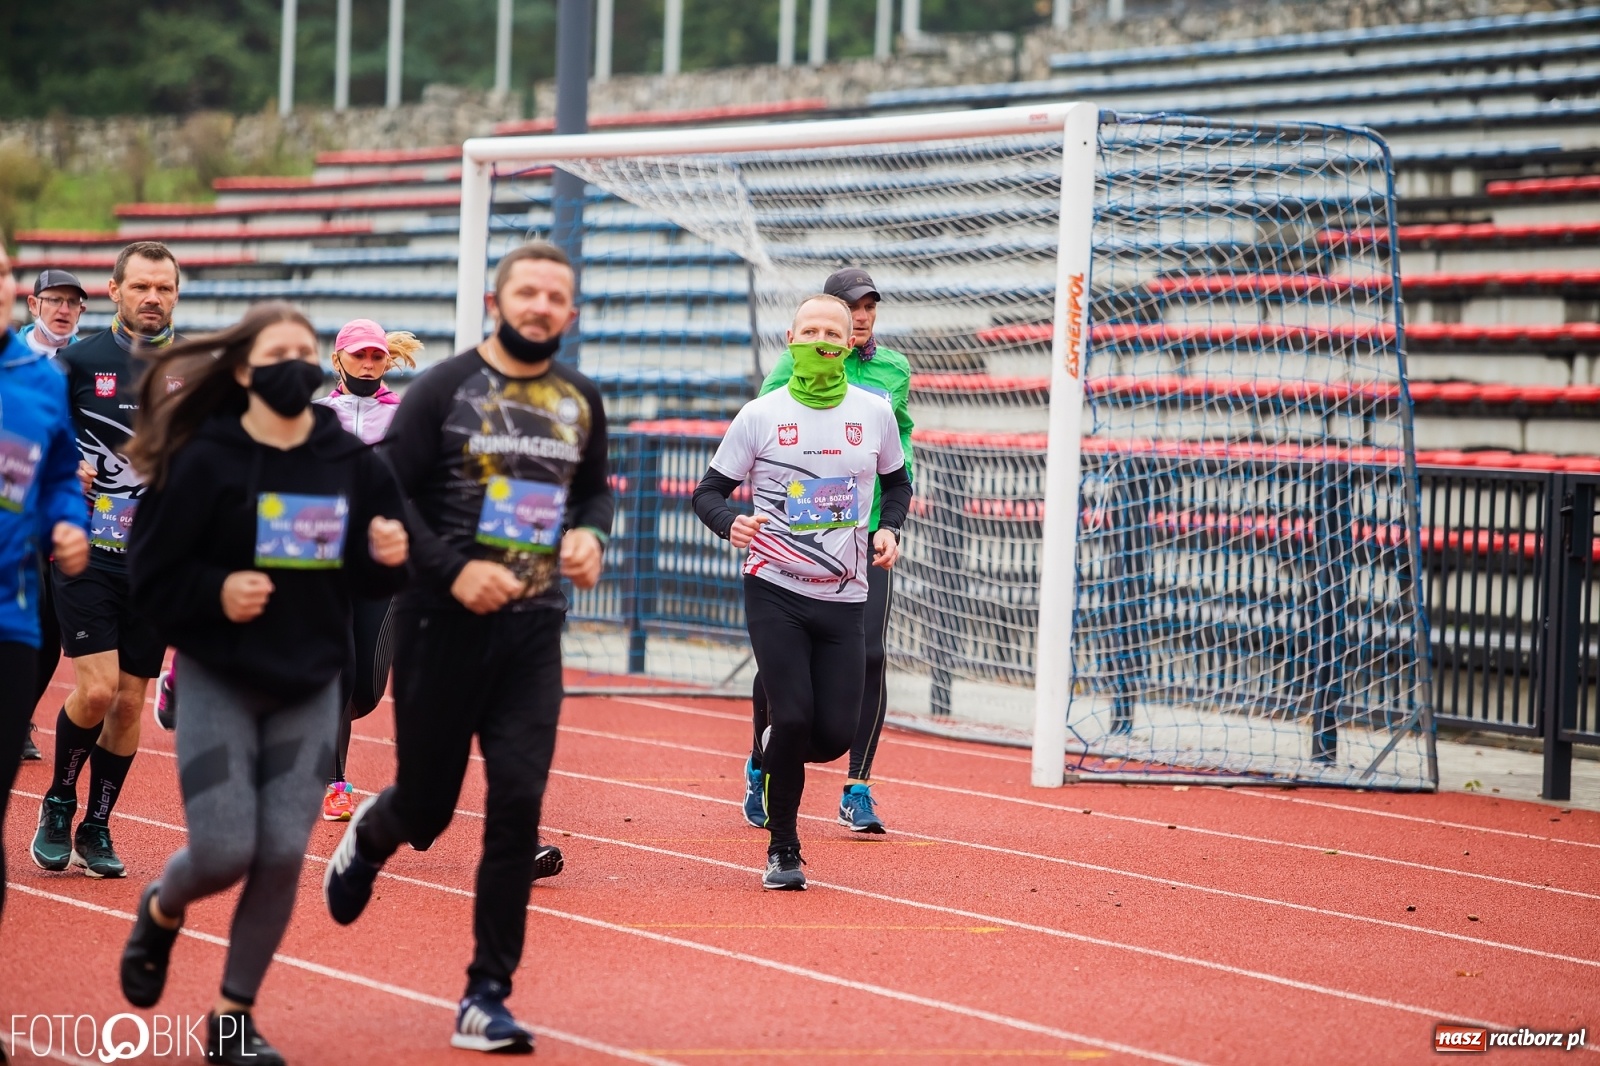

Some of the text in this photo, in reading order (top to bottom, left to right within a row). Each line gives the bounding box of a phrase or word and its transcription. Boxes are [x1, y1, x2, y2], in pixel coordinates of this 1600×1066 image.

[102, 513, 133, 523] BIEG DLA
[831, 508, 853, 522] 236
[62, 748, 86, 786] Kalenji
[93, 778, 117, 820] Kalenji
